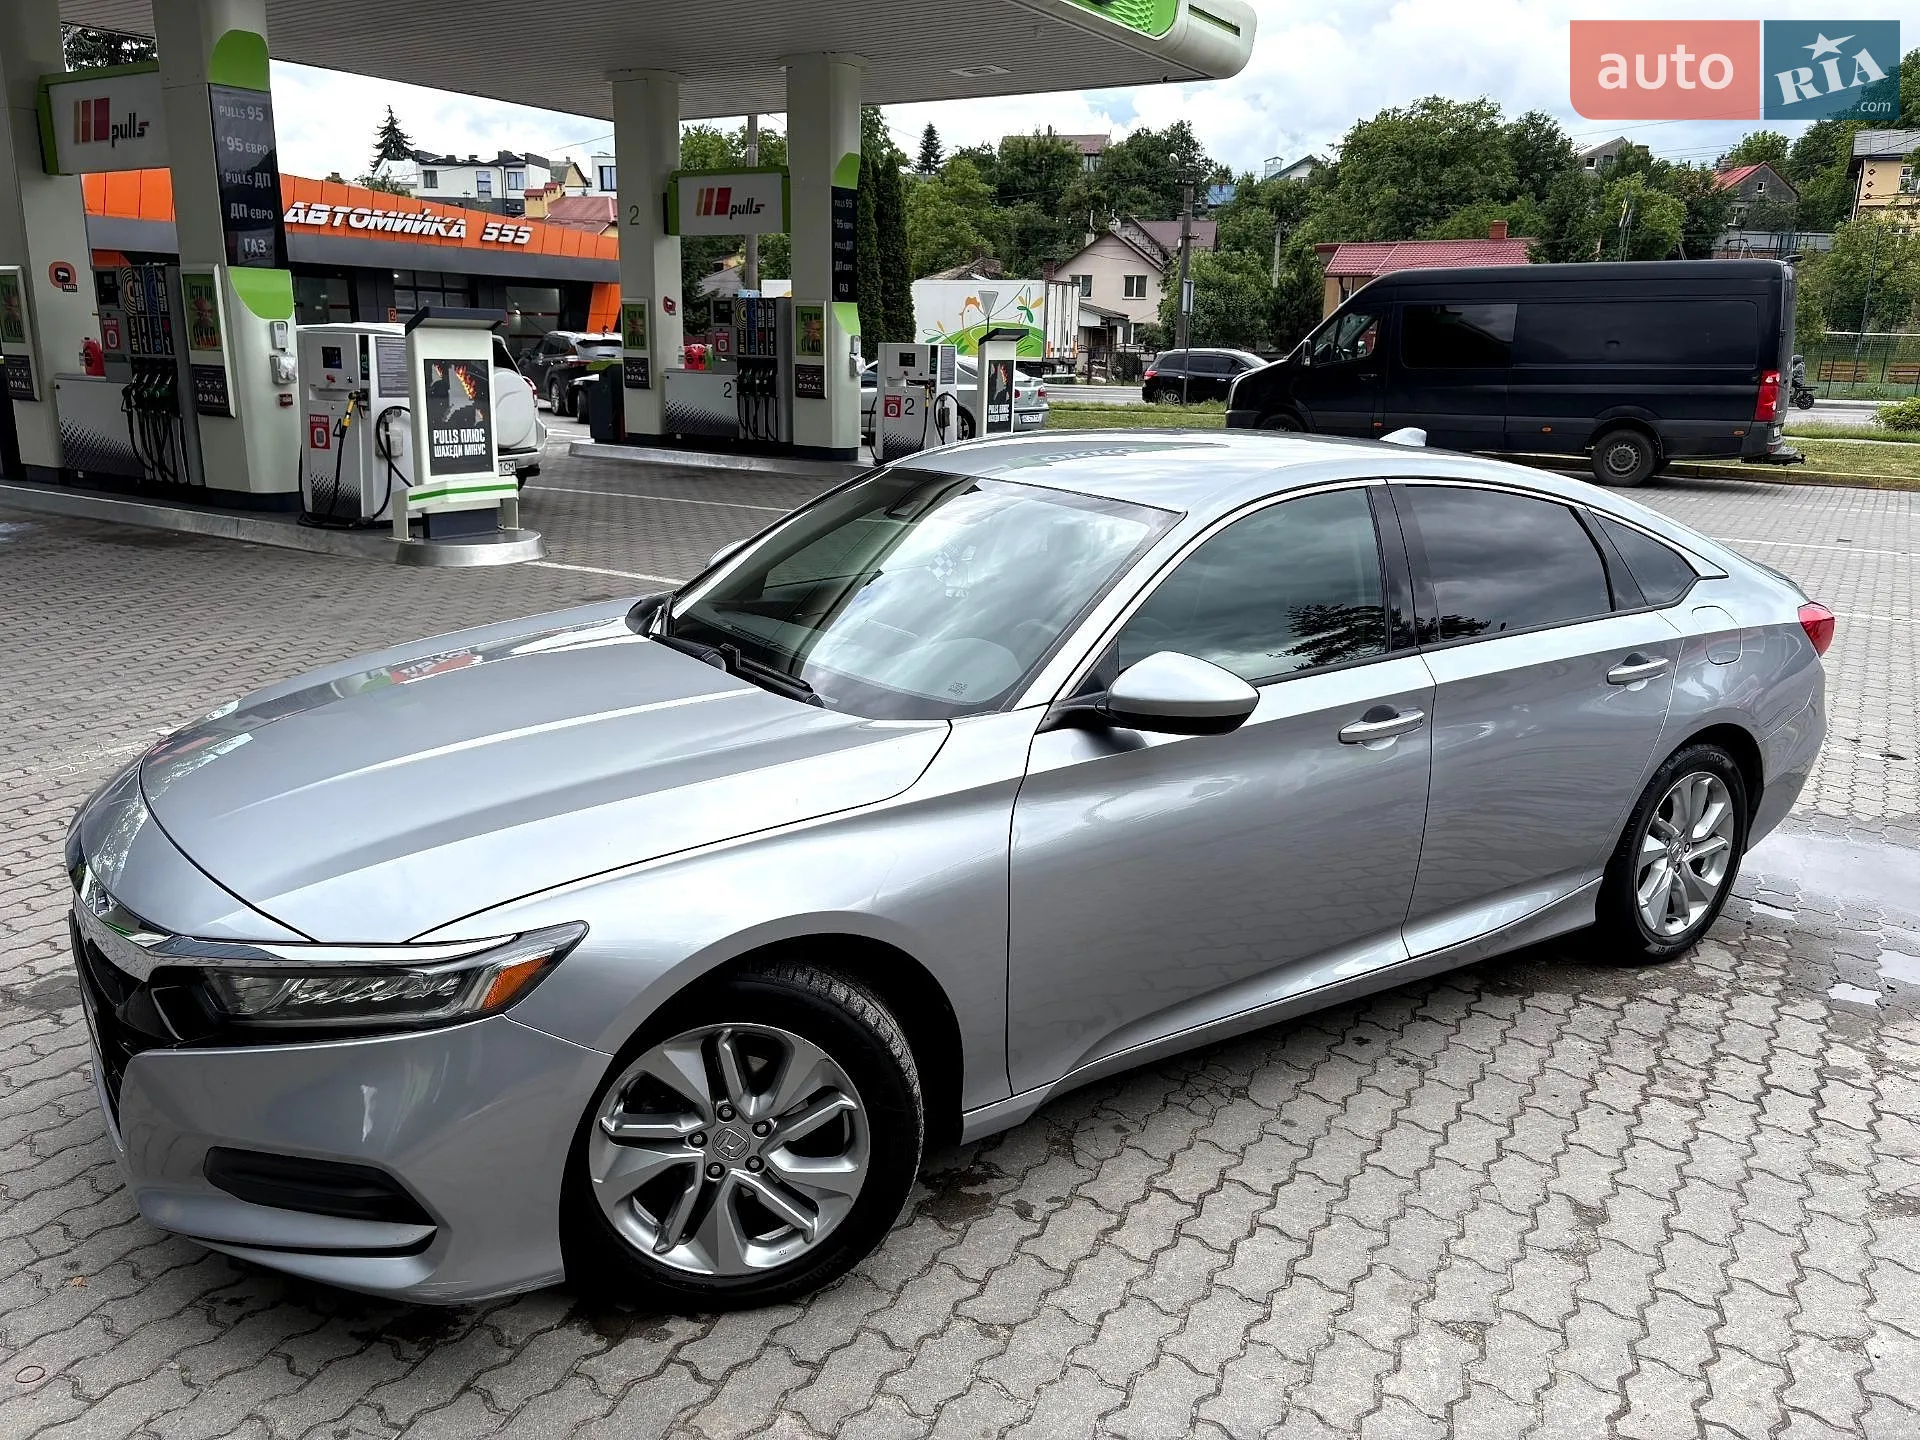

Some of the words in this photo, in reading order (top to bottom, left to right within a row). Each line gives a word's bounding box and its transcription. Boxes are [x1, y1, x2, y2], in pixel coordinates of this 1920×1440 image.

[219, 105, 246, 119] PULLS
[247, 105, 264, 122] 95
[111, 112, 150, 148] pulls
[225, 172, 253, 185] PULLS
[254, 172, 271, 189] ДП
[230, 202, 248, 219] ДП
[629, 205, 640, 226] 2
[729, 197, 765, 220] pulls
[283, 200, 467, 239] АВТОМИЙКА
[480, 221, 533, 245] 555
[244, 237, 266, 253] ГАЗ
[723, 381, 733, 398] 2
[904, 398, 915, 416] 2
[433, 429, 459, 444] PULLS
[460, 428, 486, 443] ПЛЮС
[434, 444, 463, 458] ШАХЕДИ
[464, 442, 486, 456] МІНУС
